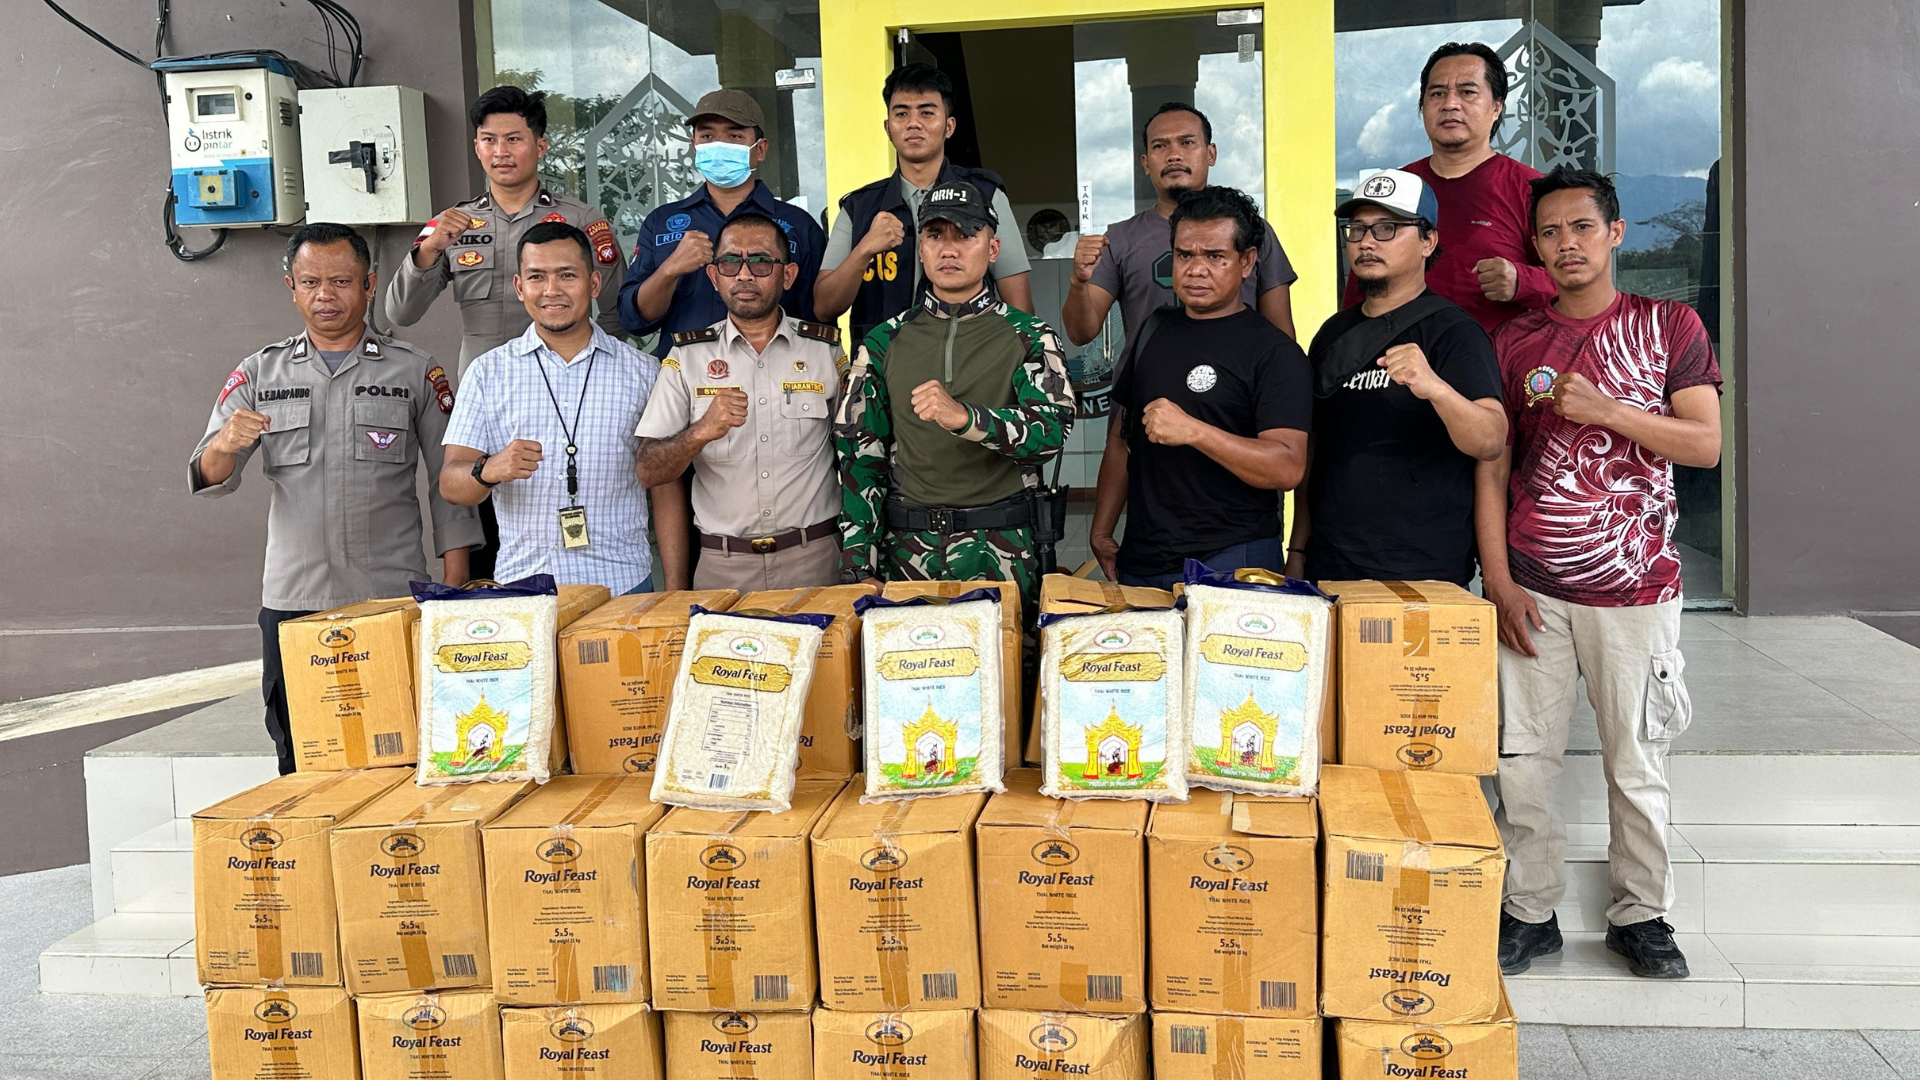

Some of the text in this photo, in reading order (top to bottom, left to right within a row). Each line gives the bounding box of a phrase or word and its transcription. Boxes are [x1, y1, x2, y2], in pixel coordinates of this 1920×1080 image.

[202, 128, 232, 140] listrik
[203, 141, 233, 151] pintar
[931, 189, 967, 202] ARH-1
[663, 232, 682, 243] RID
[355, 385, 409, 399] POLRI
[310, 651, 370, 667] Royal Feast
[454, 651, 508, 664] Royal Feast
[1223, 644, 1284, 660] Royal Feast
[899, 658, 956, 671] Royal Feast
[1082, 661, 1141, 674] Royal Feast
[712, 665, 768, 681] Royal Feast
[641, 733, 661, 744] yal
[1383, 724, 1456, 738] Royal Feast
[227, 856, 296, 871] Royal Feast
[370, 863, 441, 879] Royal Feast
[524, 869, 597, 885] Royal Feast
[686, 875, 761, 891] Royal Feast
[1018, 870, 1095, 887] Royal Feast
[1189, 875, 1269, 892] Royal Feast
[849, 877, 924, 893] Royal Feast
[1369, 967, 1451, 987] Royal Feast
[244, 1027, 313, 1042] Royal Feast
[392, 1035, 462, 1050] Royal Feast
[700, 1039, 773, 1054] Royal Feast
[539, 1047, 610, 1062] Royal Feast
[852, 1050, 928, 1066] Royal Feast
[1015, 1054, 1091, 1076] Royal Feast
[1387, 1063, 1469, 1079] Royal Feast
